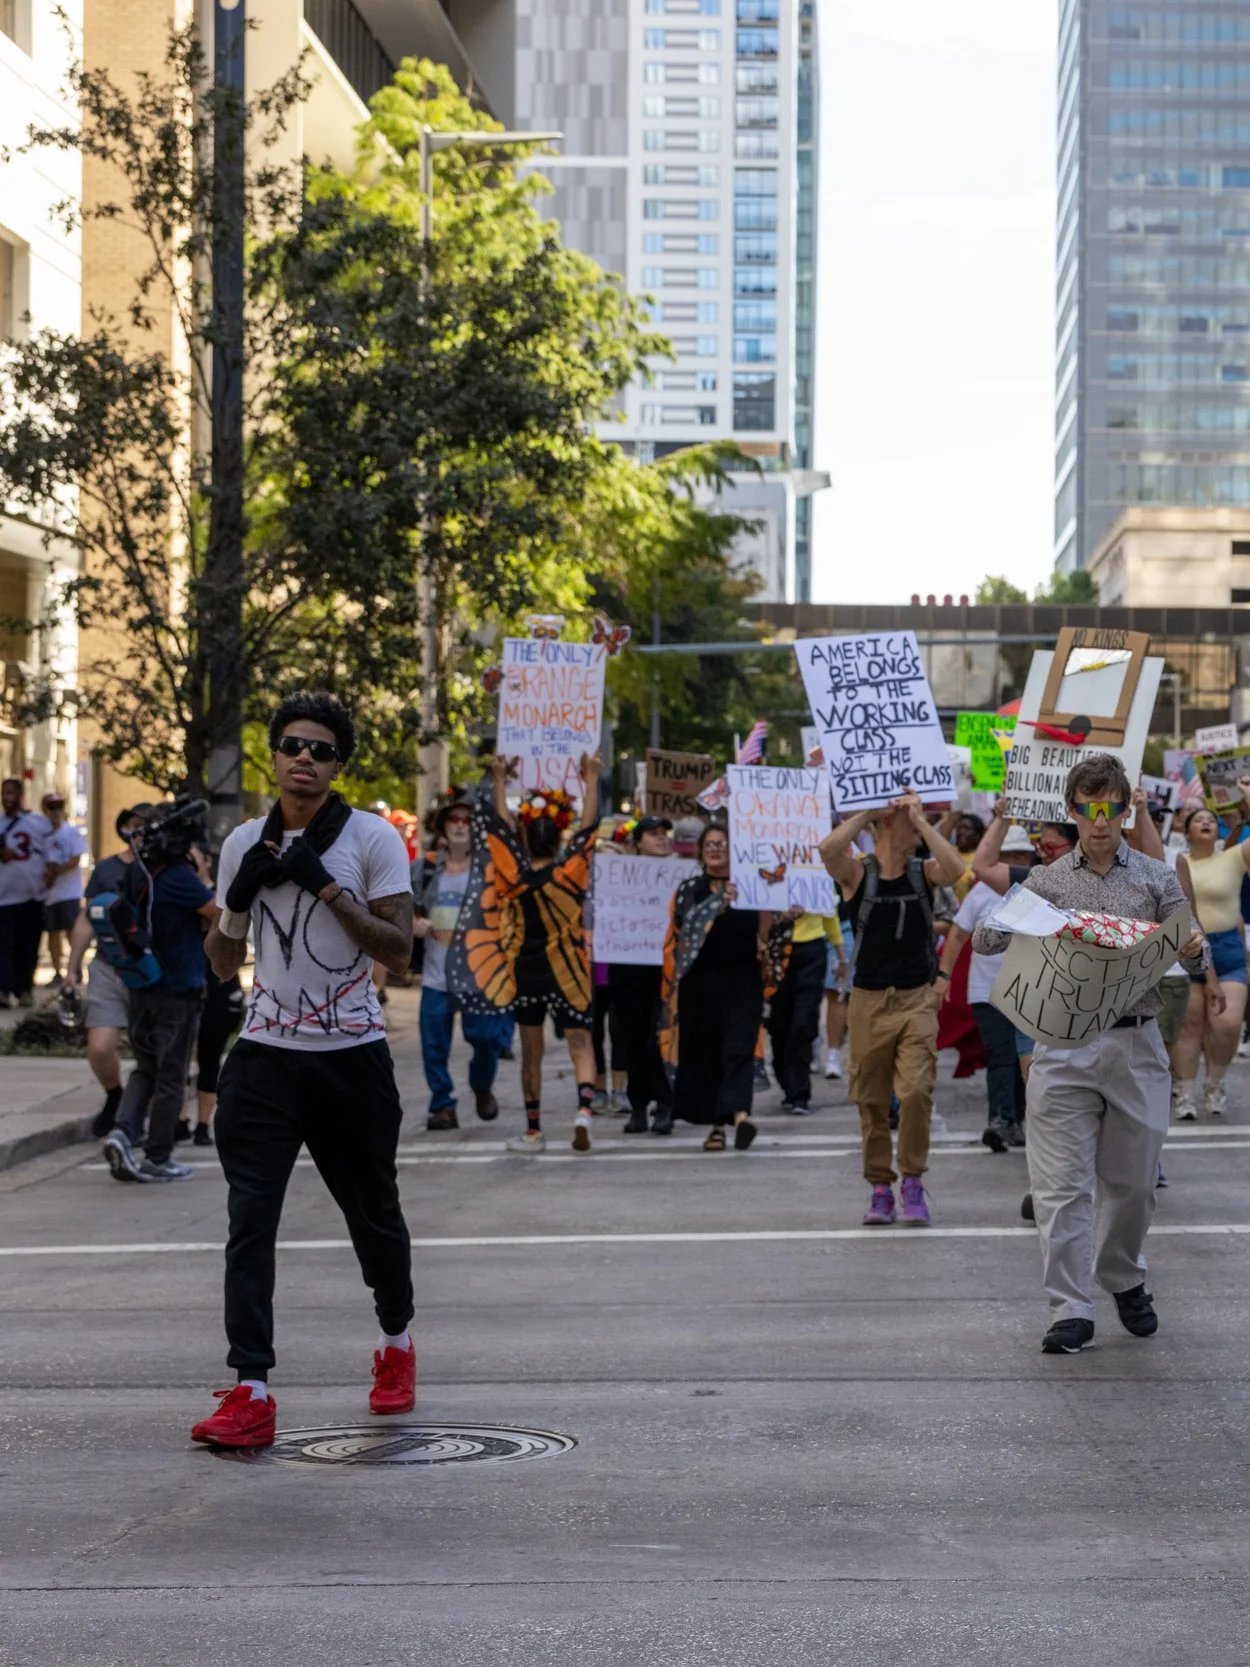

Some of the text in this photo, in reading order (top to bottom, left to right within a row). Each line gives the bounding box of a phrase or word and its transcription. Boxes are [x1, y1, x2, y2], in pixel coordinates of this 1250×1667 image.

[811, 636, 914, 666] AMERICA
[1092, 629, 1128, 648] KINGS
[506, 640, 594, 667] THE ONLY
[506, 666, 599, 700] ORANGE
[830, 656, 920, 686] BELONGS
[870, 680, 912, 699] THE
[504, 703, 598, 732] MONARCH
[816, 701, 929, 729] WORKING
[502, 726, 533, 742] THAT
[841, 728, 896, 751] CLASS
[531, 743, 570, 756] IN THE
[831, 747, 911, 775] NOT THE
[1010, 745, 1105, 768] BIG BEAUTIF
[518, 756, 585, 797] USA
[652, 756, 712, 781] TRUMP
[1207, 759, 1236, 772] NEXT
[734, 768, 820, 793] THE ONLY
[836, 765, 951, 799] SITTING CLASS
[1007, 771, 1067, 794] BILLIONAI
[649, 790, 699, 814] TRAS
[735, 819, 819, 844] MONARCH
[12, 832, 31, 861] 3
[734, 842, 769, 864] WE
[734, 874, 770, 907] NO
[257, 888, 363, 976] NO
[1038, 924, 1180, 985] ECTION
[1035, 949, 1155, 1012] TRUTH
[1003, 973, 1146, 1041] ALLIAN
